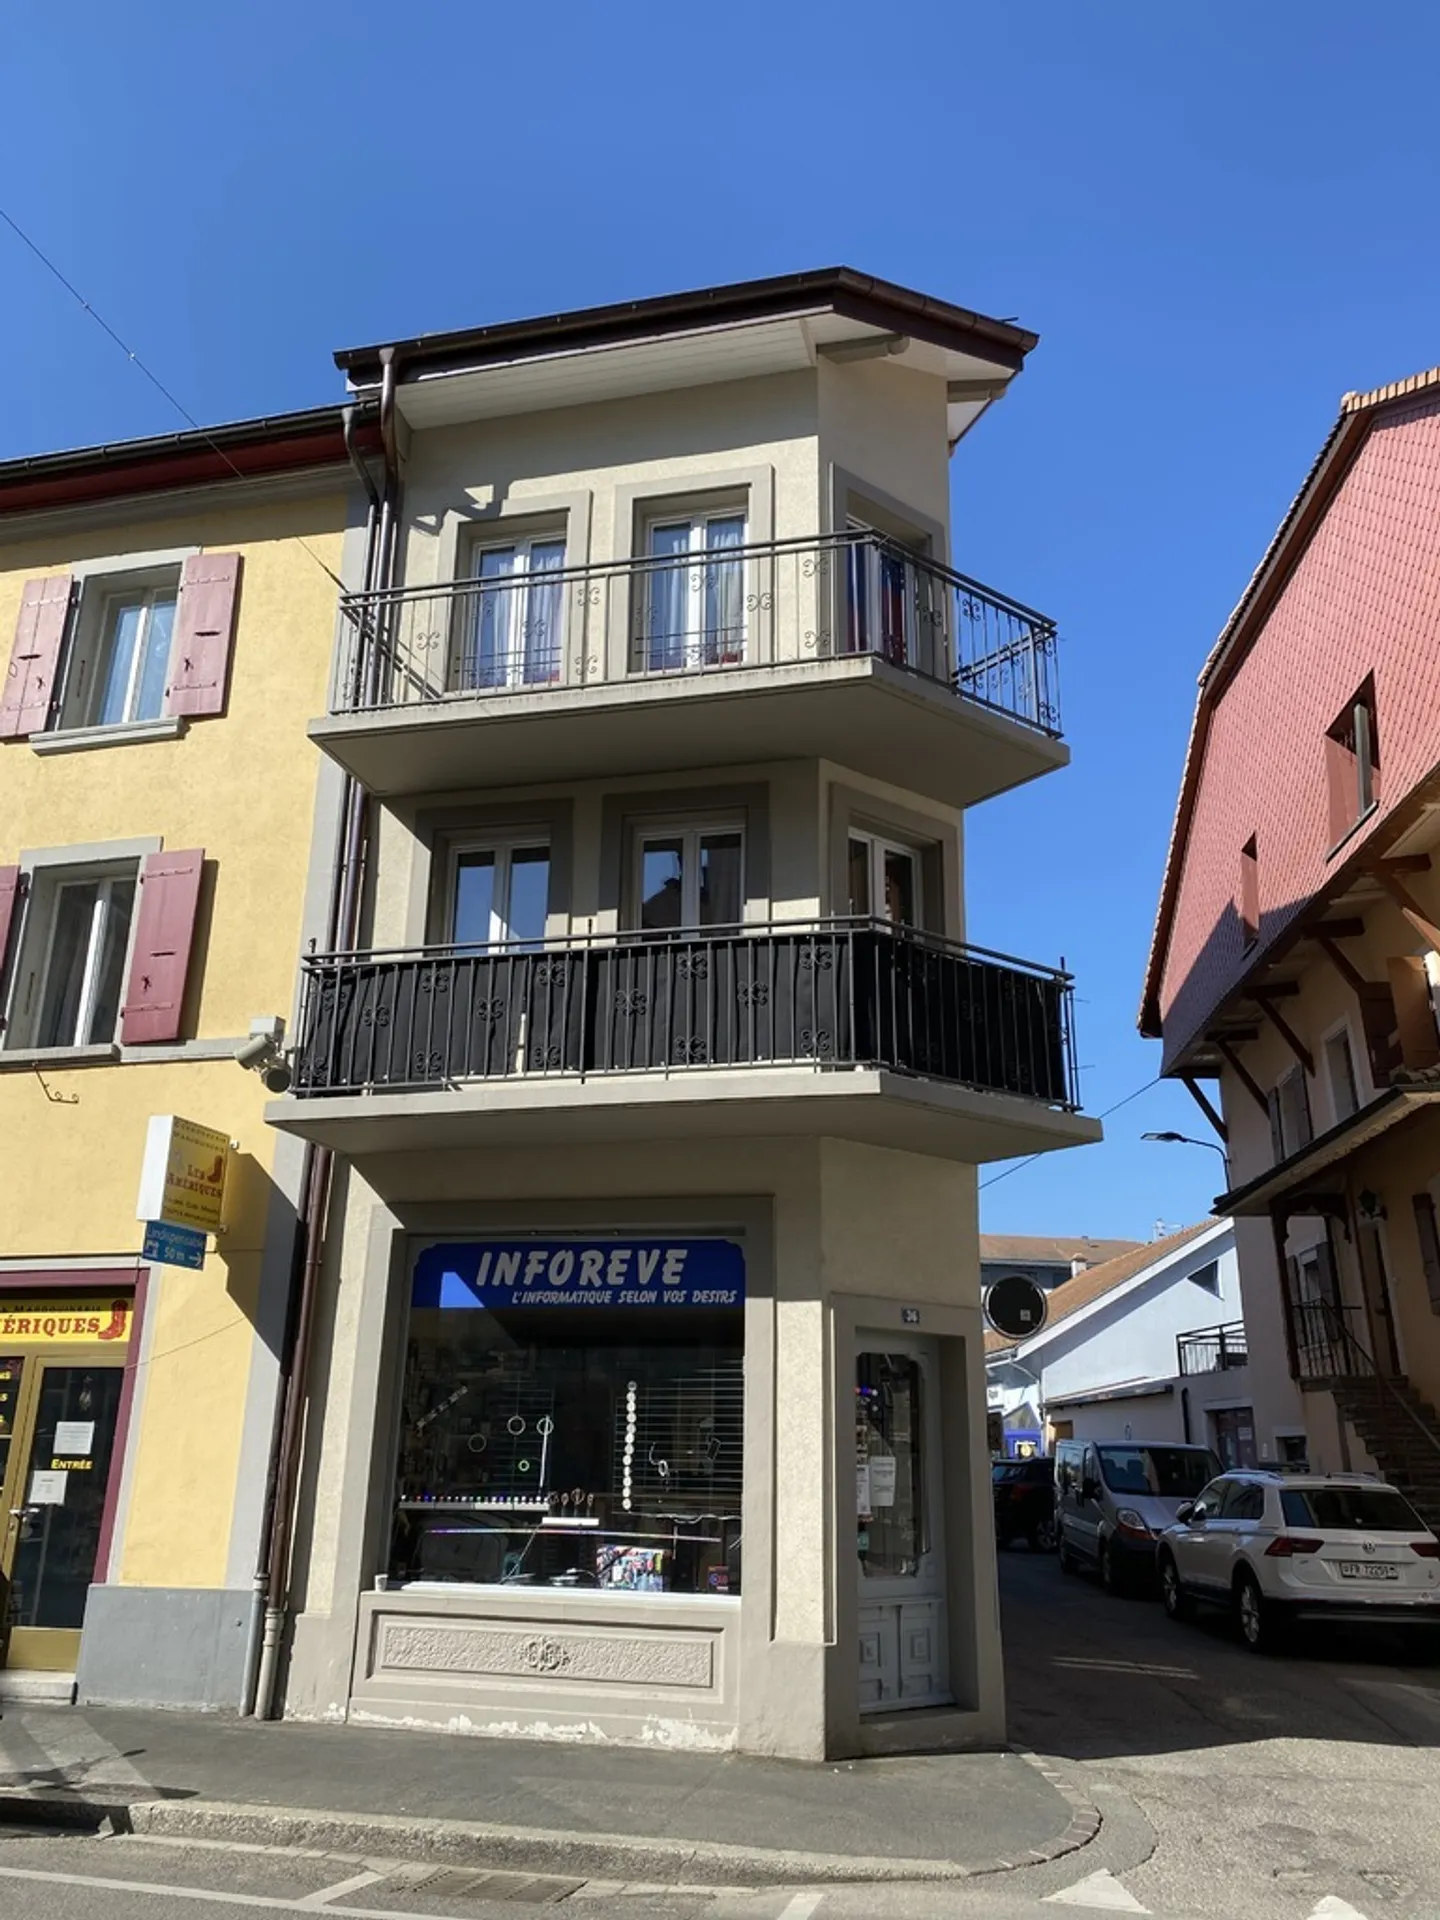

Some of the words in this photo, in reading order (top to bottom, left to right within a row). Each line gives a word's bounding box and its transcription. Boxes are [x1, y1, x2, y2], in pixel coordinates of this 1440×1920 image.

[476, 1249, 688, 1287] INFOREVE
[511, 1290, 613, 1305] L'INFORMATIQUE
[617, 1290, 658, 1304] SELON
[663, 1290, 688, 1304] VOS
[0, 1314, 100, 1337] ÉRIQUES
